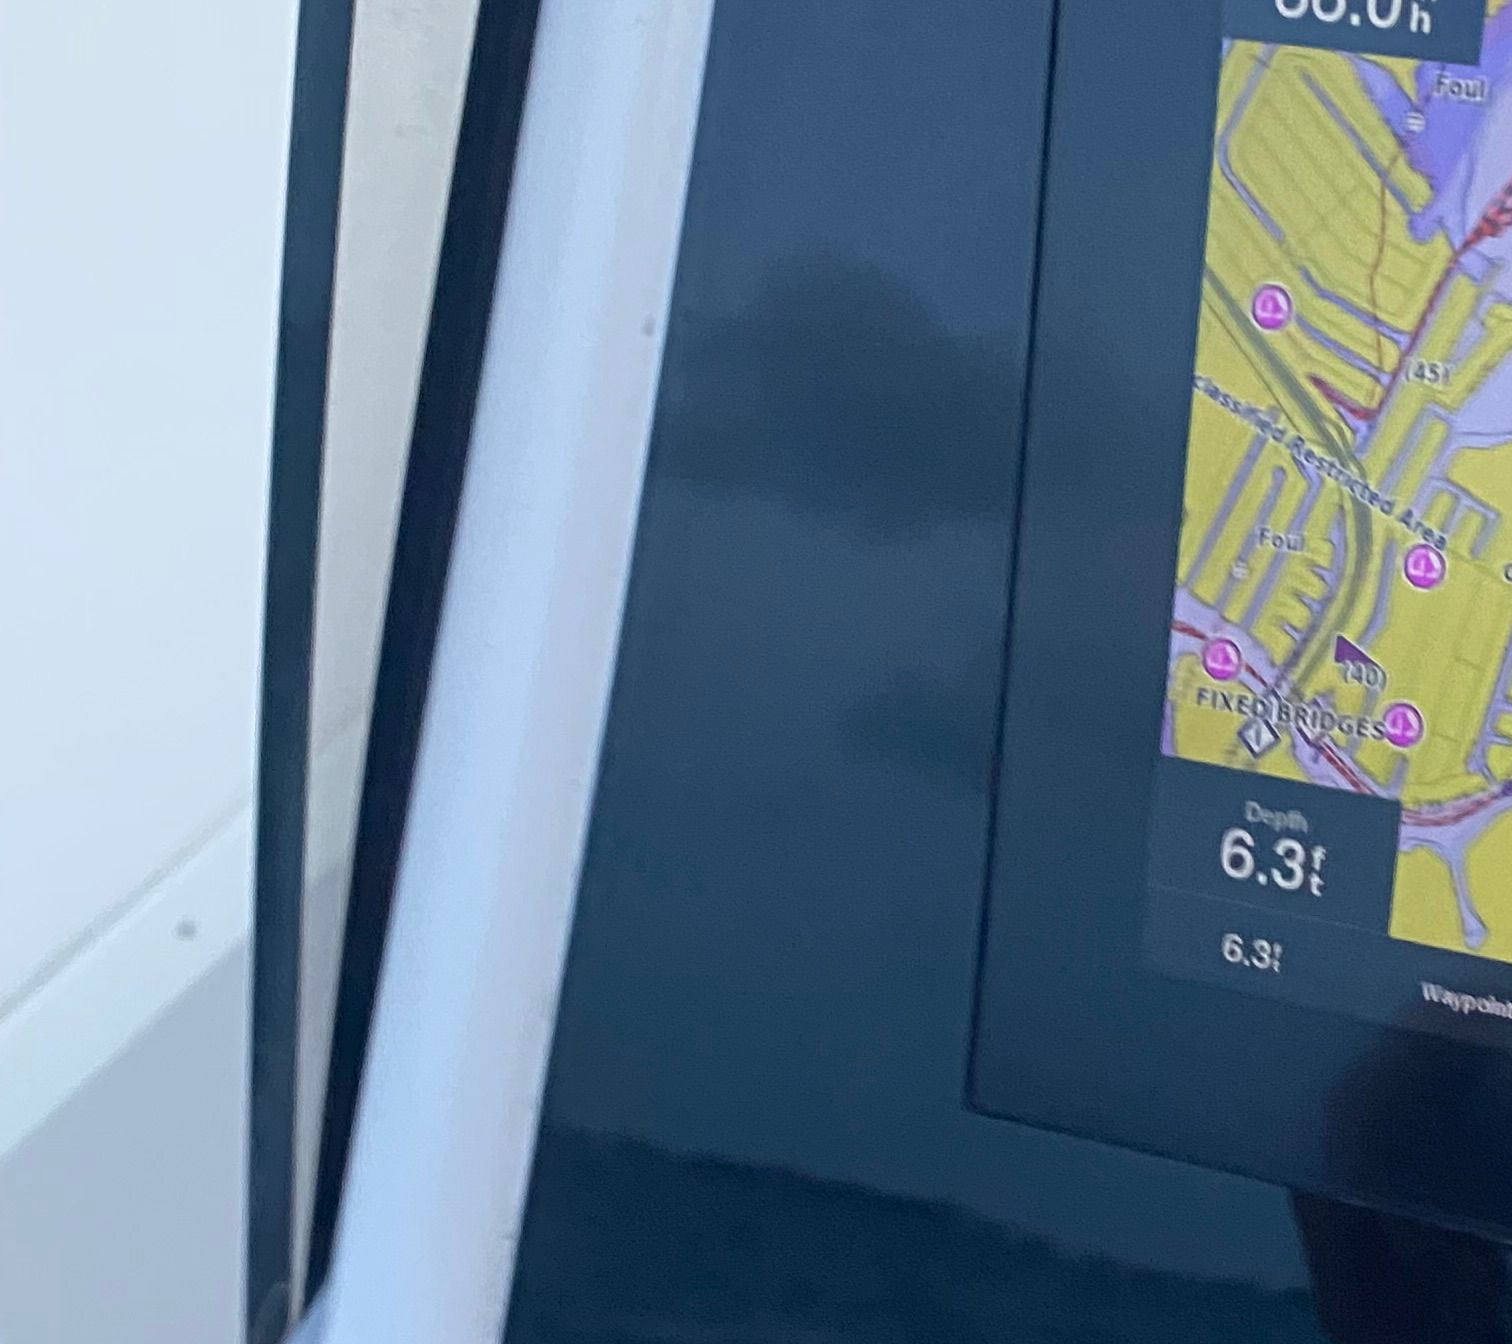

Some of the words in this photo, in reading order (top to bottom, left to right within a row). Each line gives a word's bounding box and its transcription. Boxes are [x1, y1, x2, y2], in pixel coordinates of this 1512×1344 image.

[1436, 74, 1487, 100] Foul
[1405, 360, 1450, 386] (45)
[1286, 436, 1393, 514] Restricted
[1400, 509, 1446, 551] Area
[1196, 687, 1270, 717] FIXED
[1278, 706, 1386, 741] BRIDGES
[1245, 800, 1309, 833] Depth
[1220, 827, 1304, 891] 6.3
